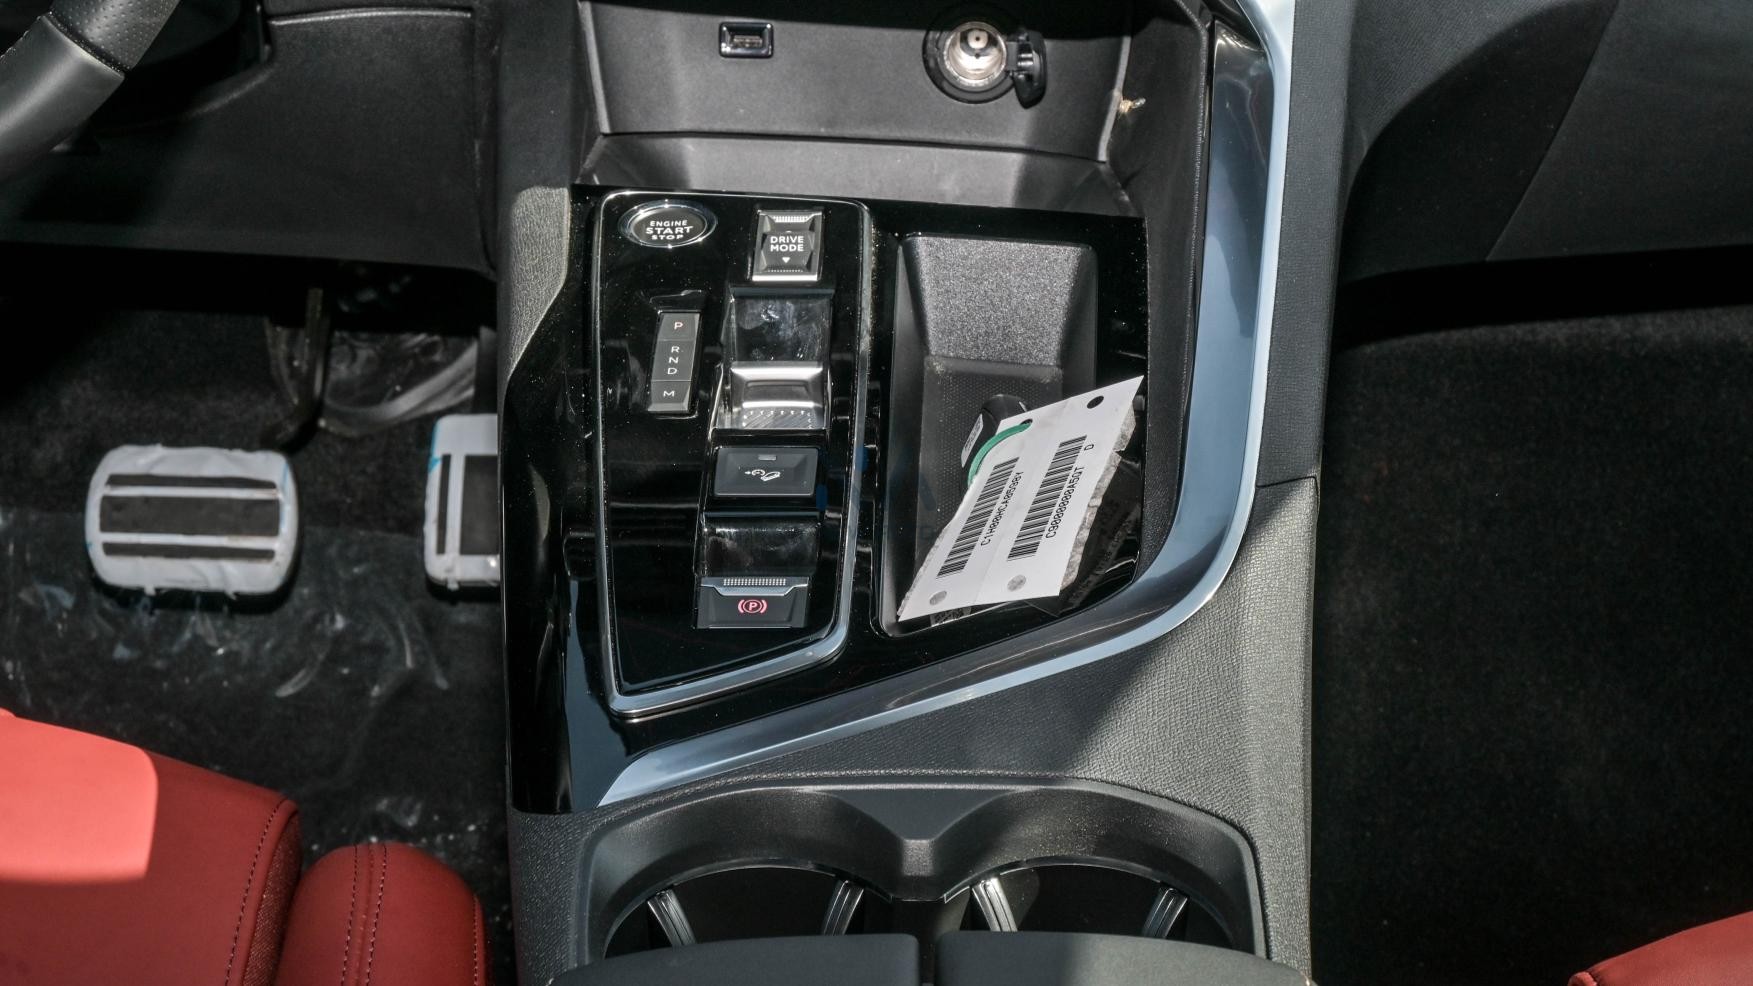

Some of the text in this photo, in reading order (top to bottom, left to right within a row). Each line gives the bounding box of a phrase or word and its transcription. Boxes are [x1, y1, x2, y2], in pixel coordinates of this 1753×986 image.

[646, 226, 693, 234] START
[770, 235, 804, 244] DRIVE
[770, 244, 804, 252] MODE
[674, 321, 684, 330] P
[671, 345, 680, 353] R
[668, 356, 679, 364] N
[667, 367, 678, 375] D
